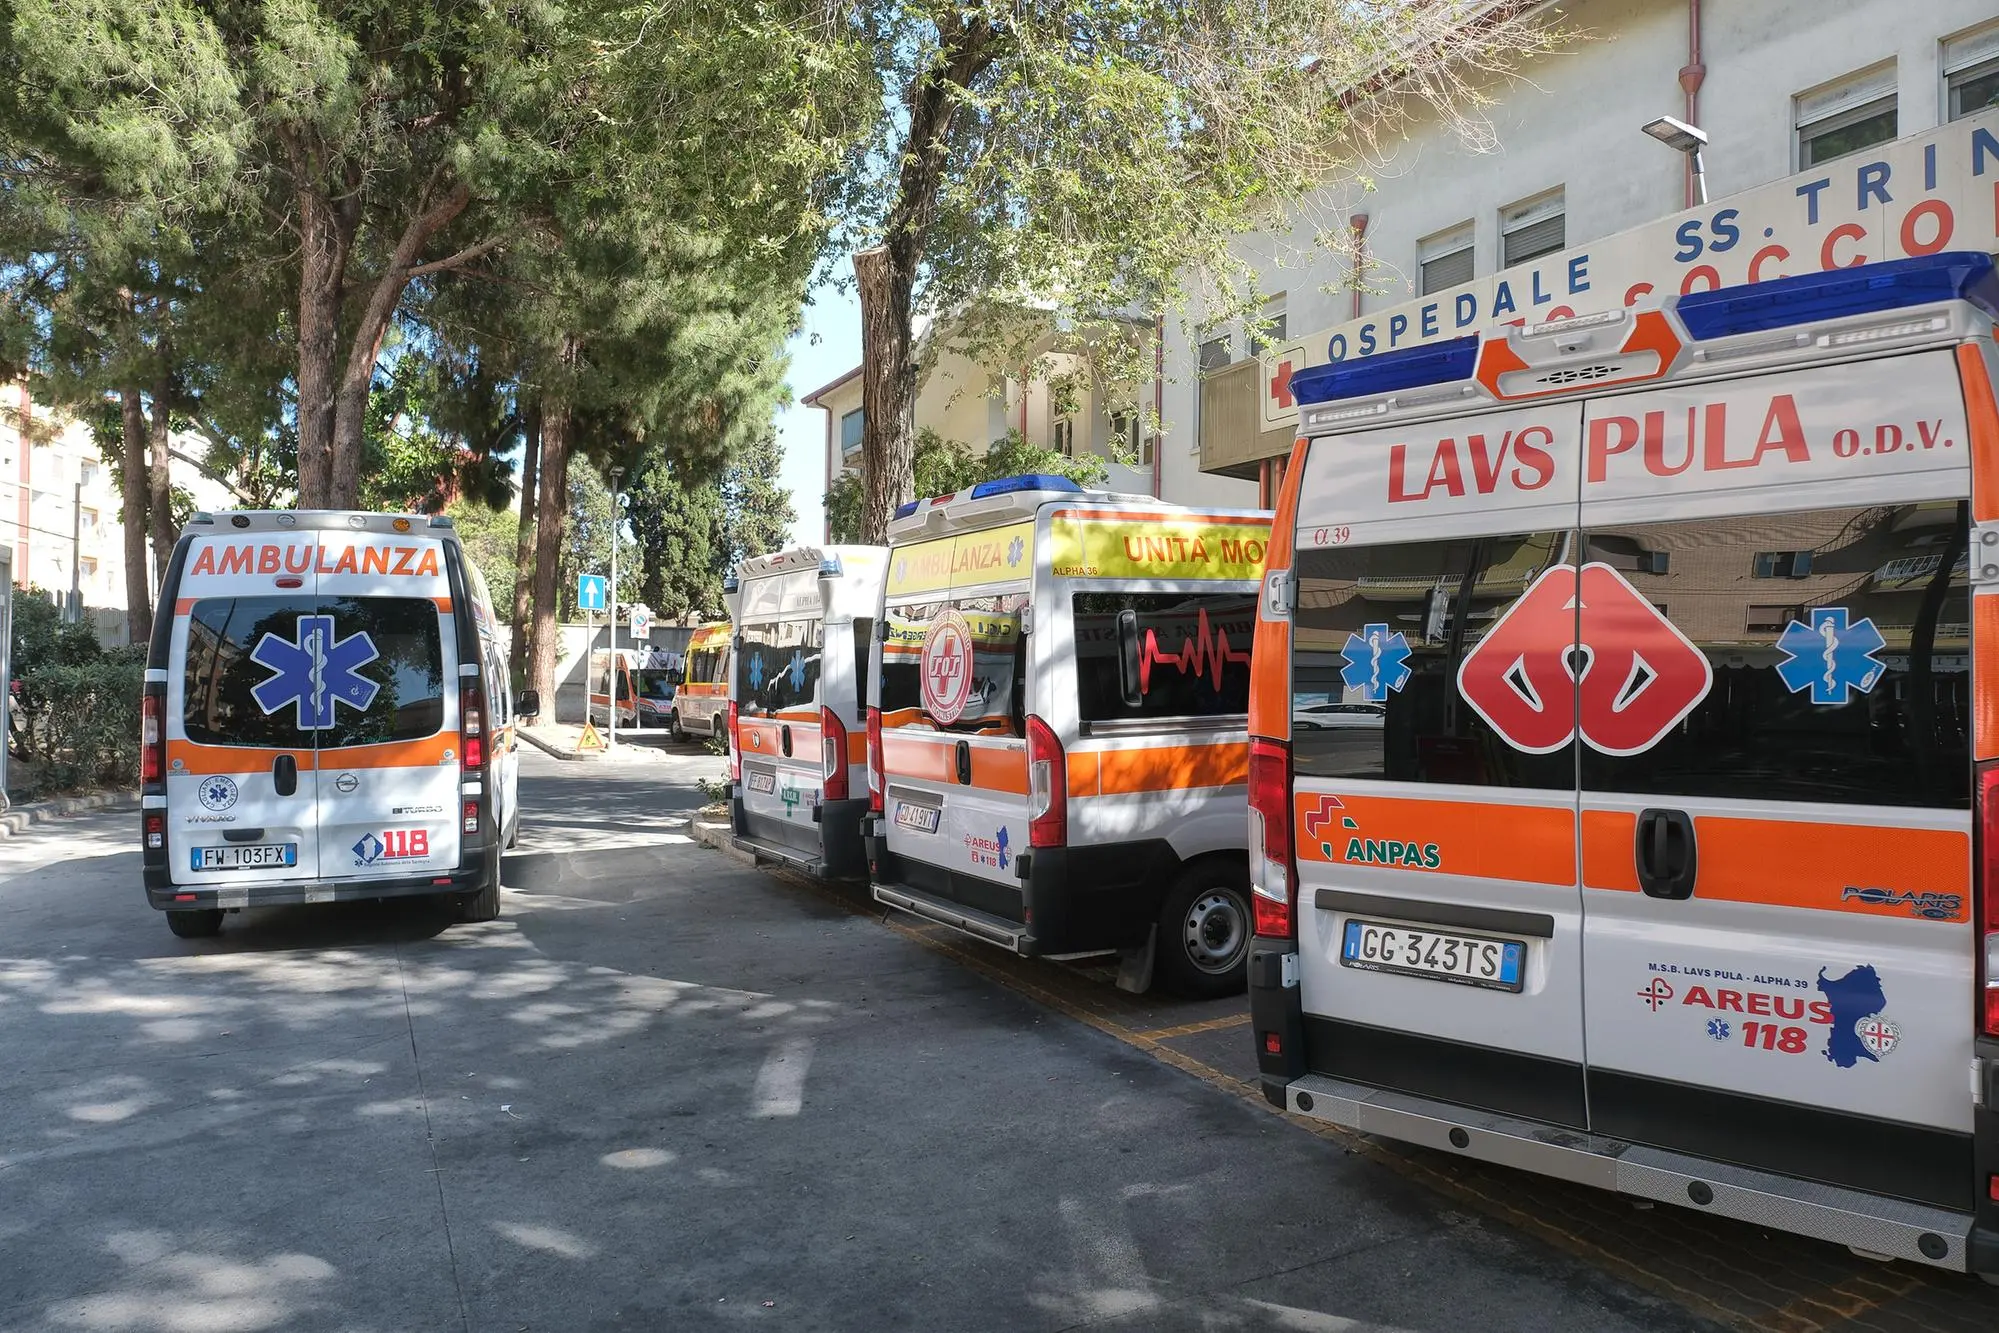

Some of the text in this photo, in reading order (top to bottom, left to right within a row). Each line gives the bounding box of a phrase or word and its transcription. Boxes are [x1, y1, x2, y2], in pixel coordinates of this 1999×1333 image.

[1328, 254, 1591, 363] OSPEDALE
[1388, 394, 1955, 503] LAVS PULA O.D.V.
[1123, 535, 1270, 565] UNITÀ MO
[1332, 526, 1350, 544] 39
[191, 544, 439, 577] AMBULANZA
[910, 541, 1002, 579] AMBULANZA
[1053, 567, 1098, 576] ALPHA 36
[215, 777, 238, 808] EMERGENZA
[185, 815, 237, 824] VIVARO
[205, 849, 225, 866] FW
[234, 847, 284, 865] 103FX
[383, 829, 429, 857] 118
[972, 837, 1001, 853] AREUS
[1346, 837, 1441, 869] ANPAS
[986, 854, 997, 866] 118
[1840, 885, 1963, 911] POLARIS
[1363, 928, 1396, 962] GG
[1406, 934, 1498, 977] 343TS
[1648, 962, 1681, 975] M.S.B.
[1684, 966, 1711, 978] LAVS
[1714, 969, 1743, 981] PULA
[1753, 974, 1791, 987] ALPHA
[1794, 978, 1809, 989] 39
[1682, 985, 1835, 1025] AREUS
[1742, 1021, 1809, 1054] 118
